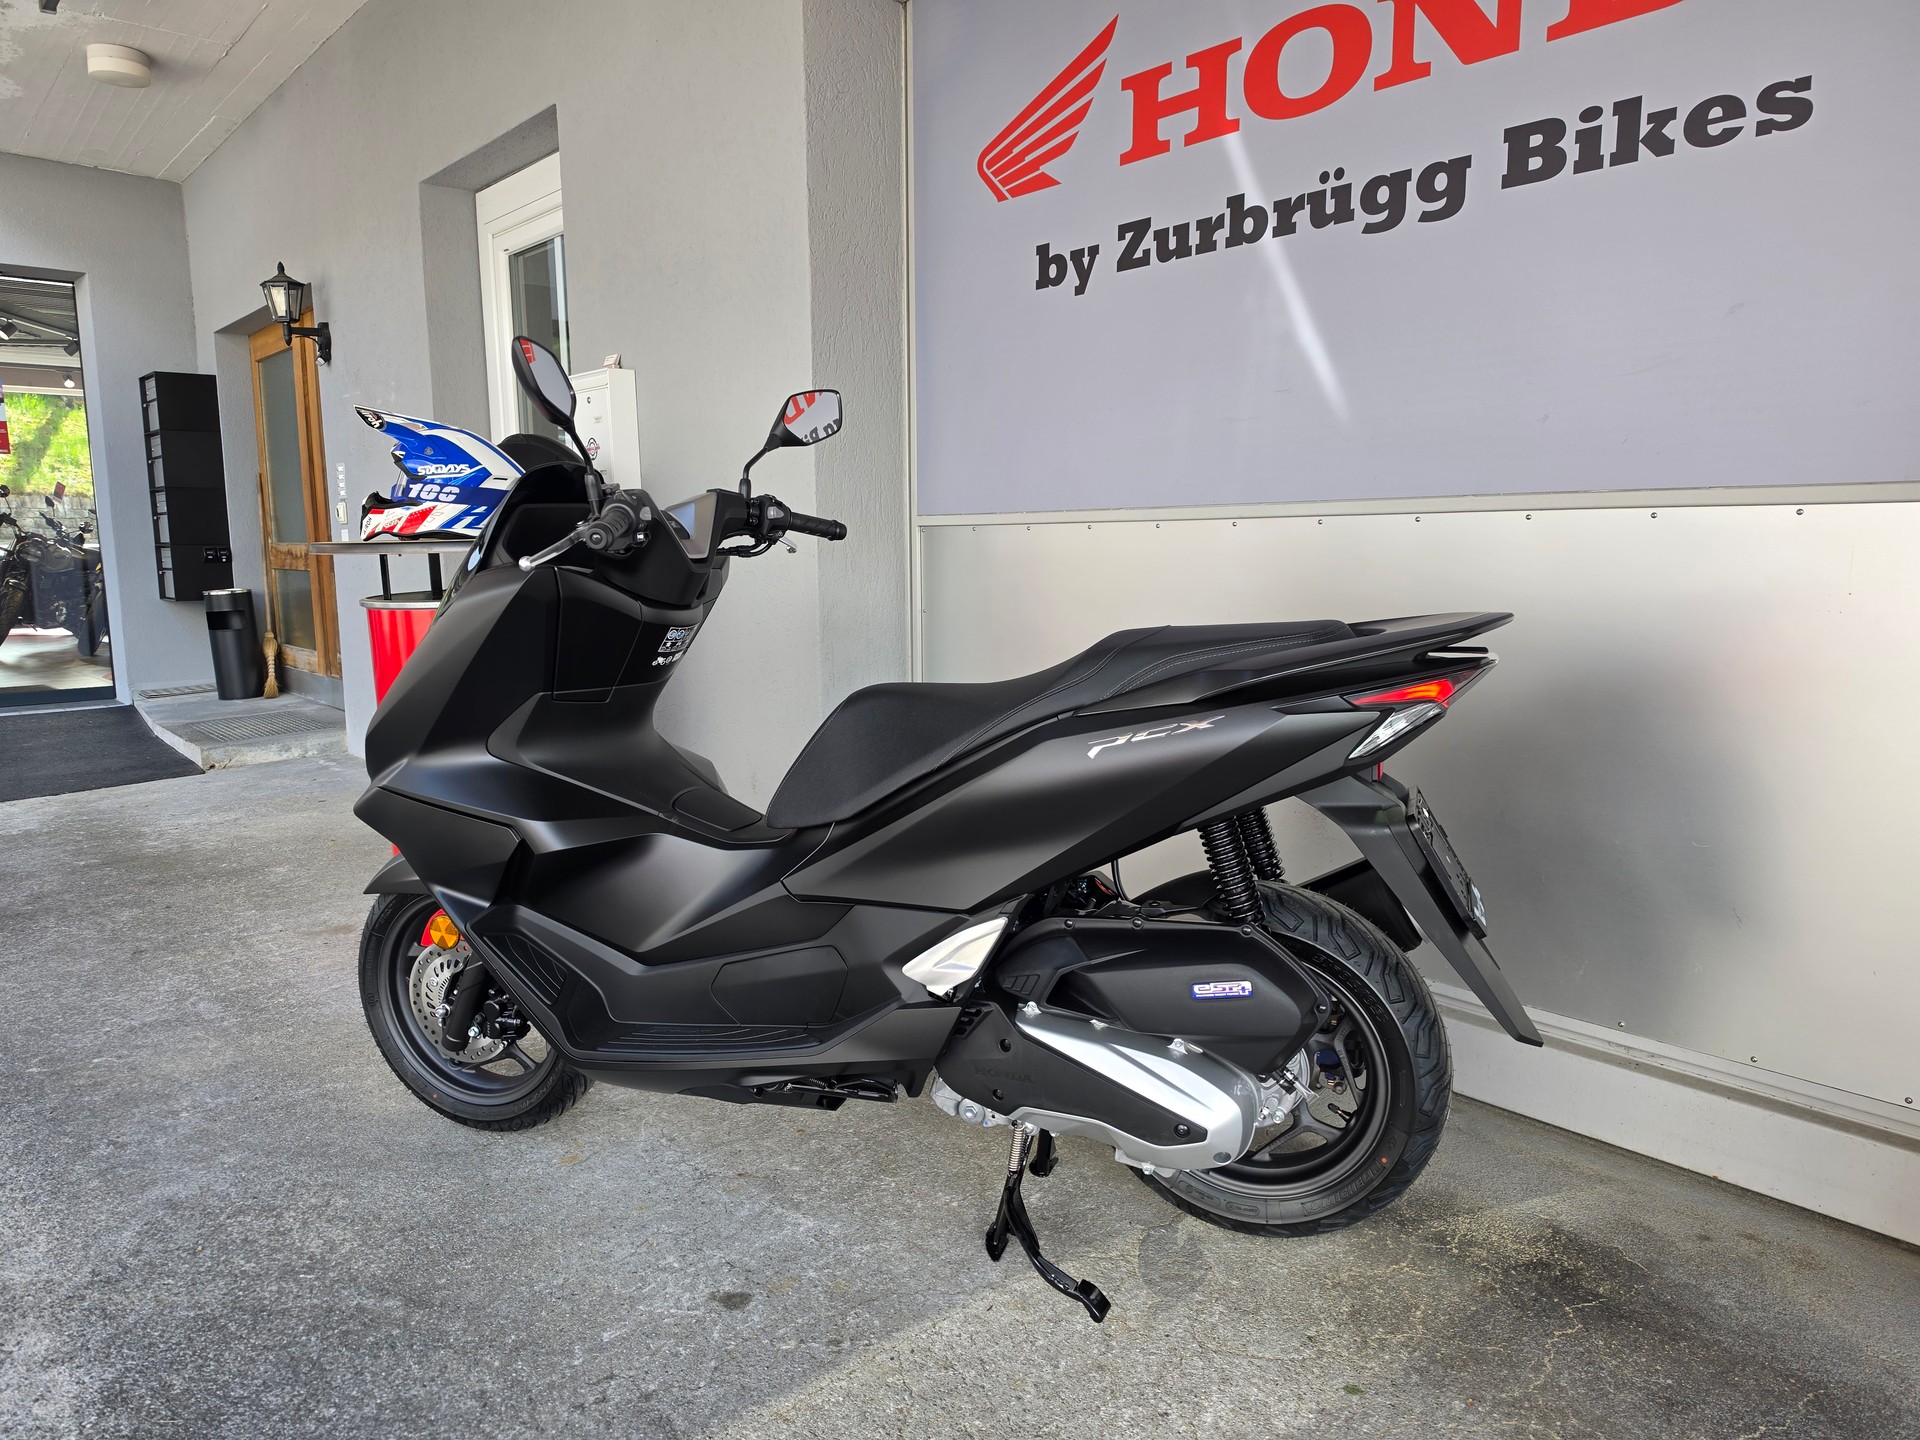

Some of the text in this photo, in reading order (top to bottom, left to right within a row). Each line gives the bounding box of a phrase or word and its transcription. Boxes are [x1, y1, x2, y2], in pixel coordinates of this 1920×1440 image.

[1035, 74, 1815, 297] by Zurbrügg Bikes
